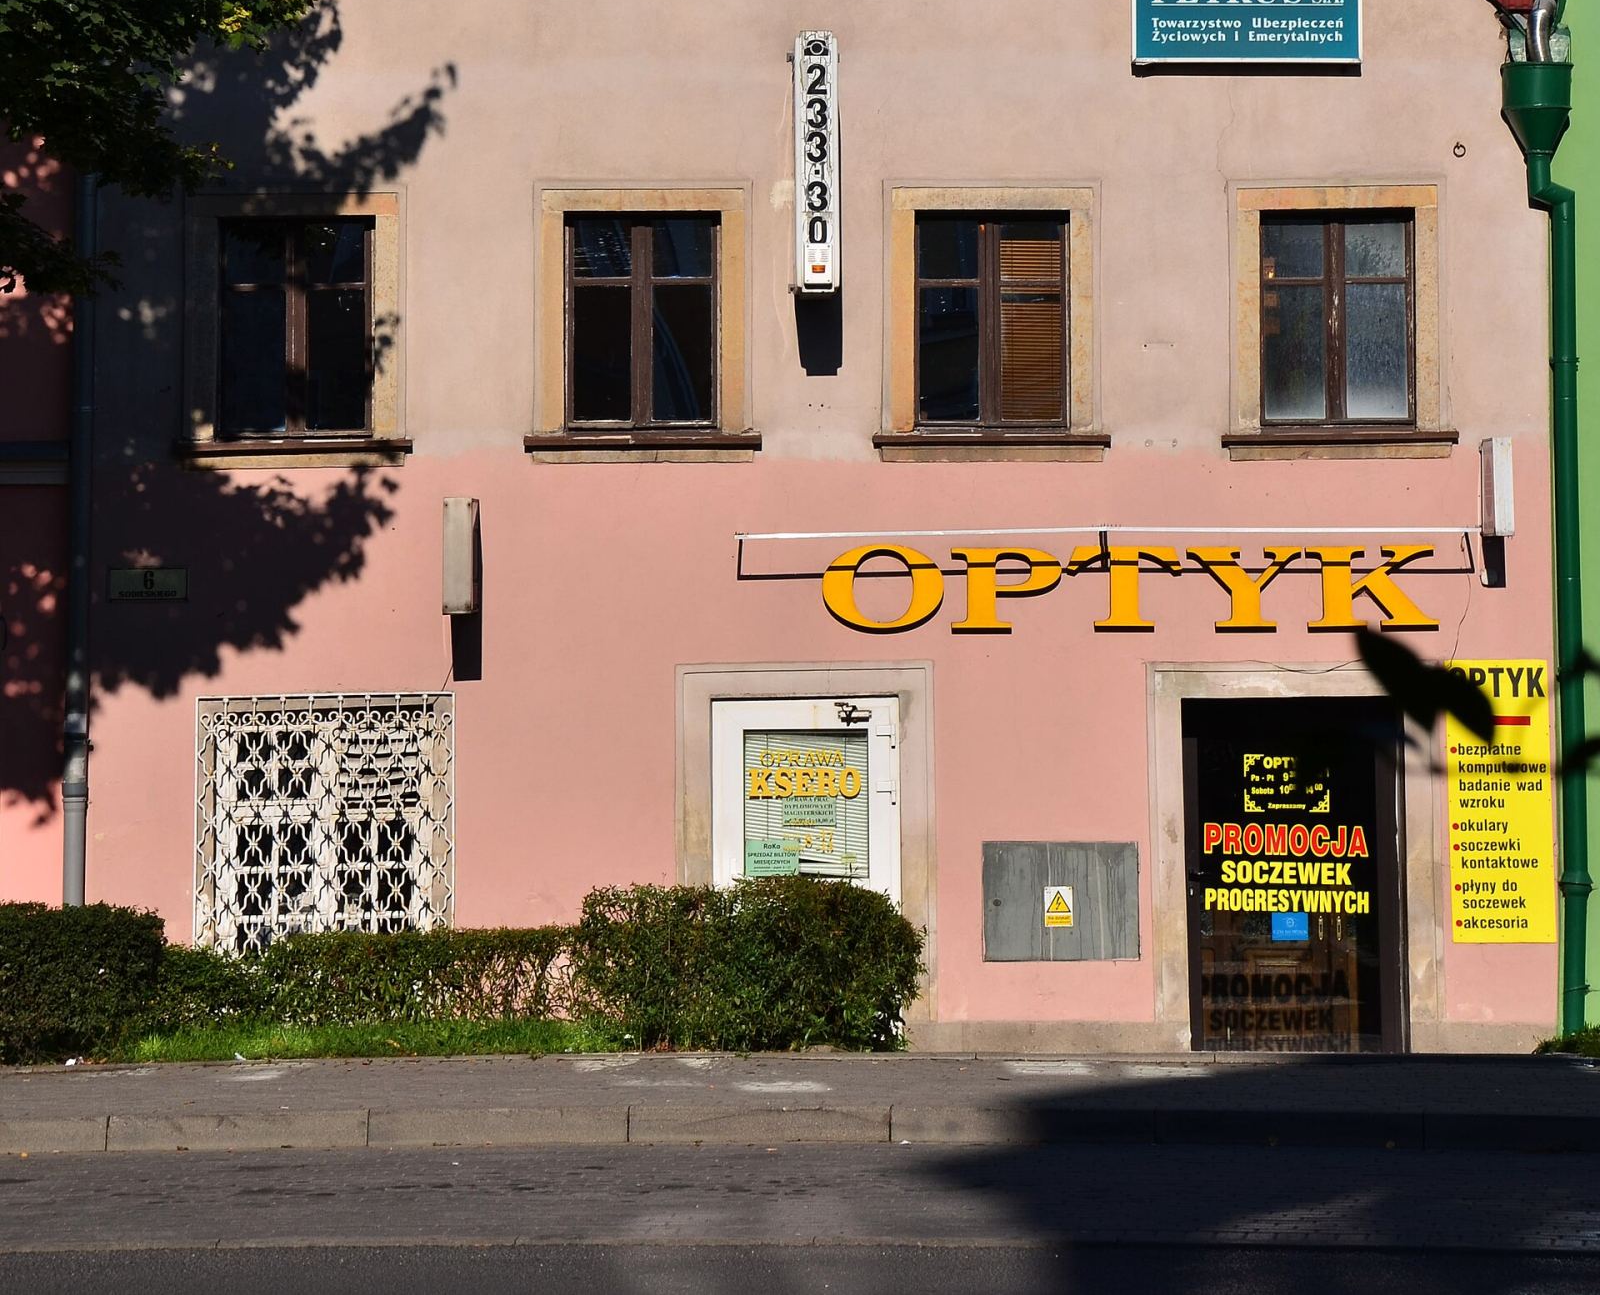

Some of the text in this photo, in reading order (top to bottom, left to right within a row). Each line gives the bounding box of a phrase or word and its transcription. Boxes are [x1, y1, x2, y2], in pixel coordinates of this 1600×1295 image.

[1151, 17, 1344, 31] Towarzystwo Ubezpieczeń
[1151, 27, 1226, 44] Życiowych
[1248, 30, 1343, 44] Emerytalnych
[143, 570, 155, 590] 6
[822, 543, 1439, 632] OPTYK
[759, 749, 845, 767] OPRAWA
[1262, 756, 1297, 770] OPT
[748, 768, 862, 800] KSERO
[1251, 786, 1275, 795] Sobota
[1459, 778, 1543, 792] badanie wad
[1459, 795, 1505, 809] wzroku
[1460, 819, 1509, 835] okulary
[1203, 822, 1369, 858] PROMOCJA
[1460, 838, 1521, 851] soczewki
[1461, 855, 1539, 869] kontaktowe
[1221, 860, 1352, 886] SOCZEWEK
[1461, 878, 1518, 895] płyny do
[1204, 888, 1369, 914] PROGRESYWNYCH
[1462, 895, 1527, 910] soczewek
[1463, 916, 1528, 930] akcesoria
